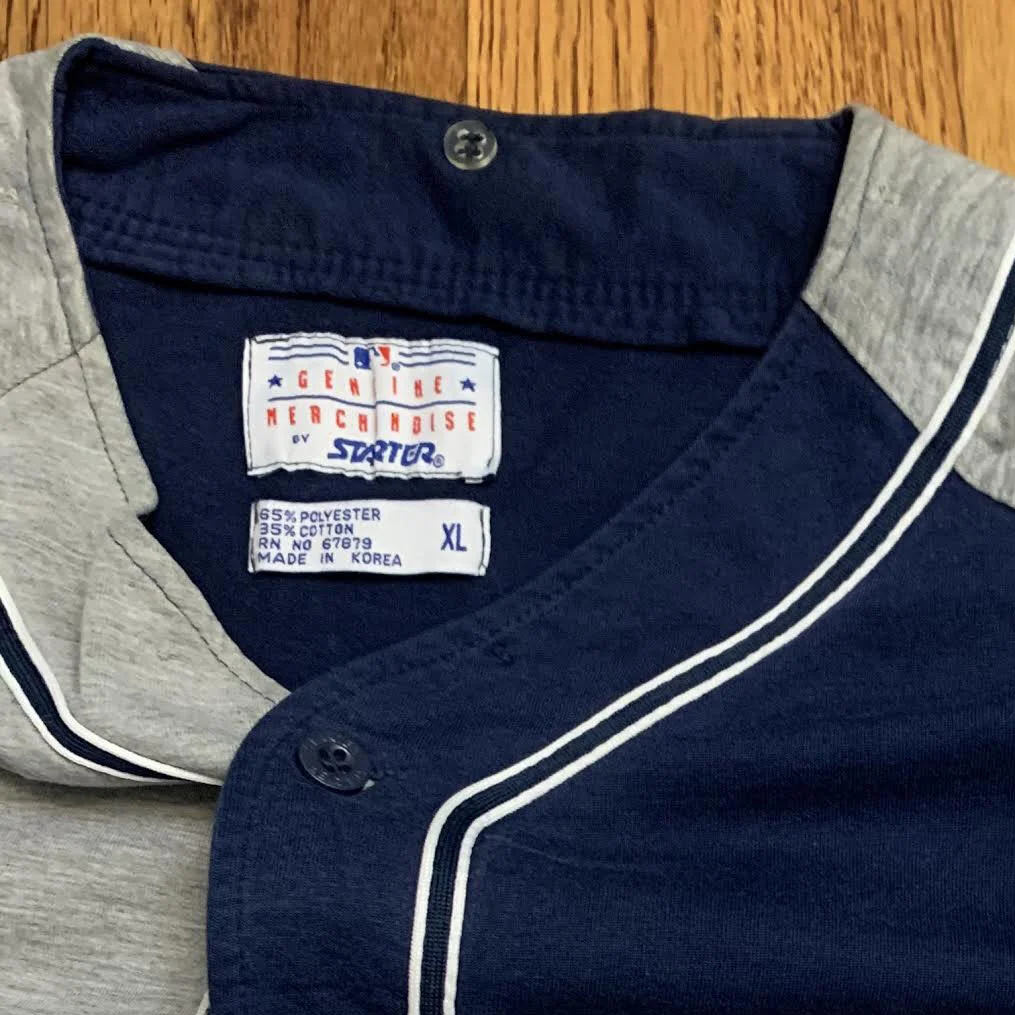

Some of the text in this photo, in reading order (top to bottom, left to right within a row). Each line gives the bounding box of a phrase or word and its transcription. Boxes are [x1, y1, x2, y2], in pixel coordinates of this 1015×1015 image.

[298, 369, 442, 398] GENINE
[266, 404, 476, 435] MERCHNDISE
[292, 434, 309, 444] BY
[259, 508, 381, 523] 65% POLYESTER
[259, 523, 354, 538] 35% COTTON
[440, 522, 468, 551] XL
[258, 538, 281, 550] RN
[292, 538, 312, 551] NO
[257, 551, 402, 567] MADE IN KOREA
